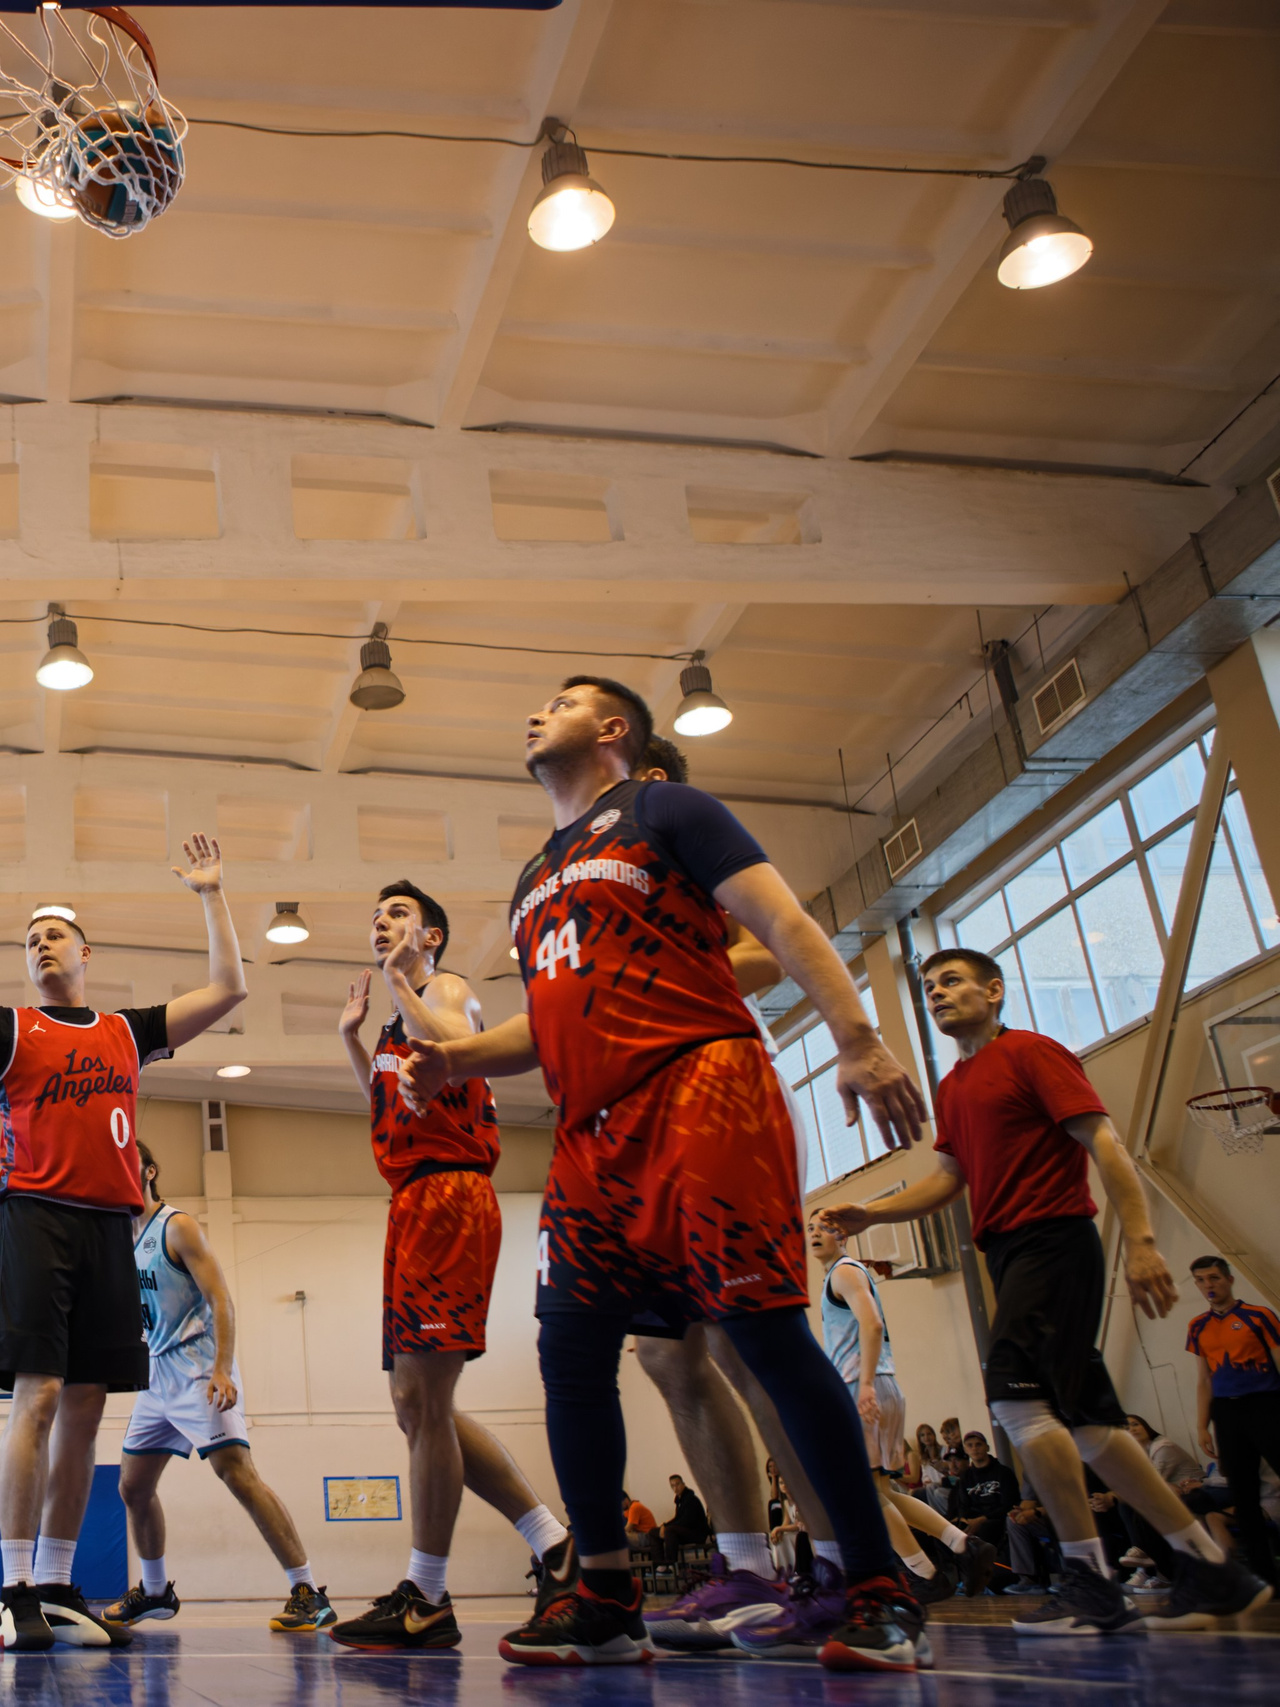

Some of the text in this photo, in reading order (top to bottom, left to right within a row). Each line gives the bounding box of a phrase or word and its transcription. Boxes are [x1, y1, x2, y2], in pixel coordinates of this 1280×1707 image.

[521, 872, 561, 918] STATE
[562, 858, 650, 895] WARRIORS
[536, 918, 581, 981] 44
[64, 1048, 108, 1076] Los
[35, 1066, 133, 1110] Angeles
[110, 1107, 129, 1149] 0
[137, 1269, 158, 1291] НЫ
